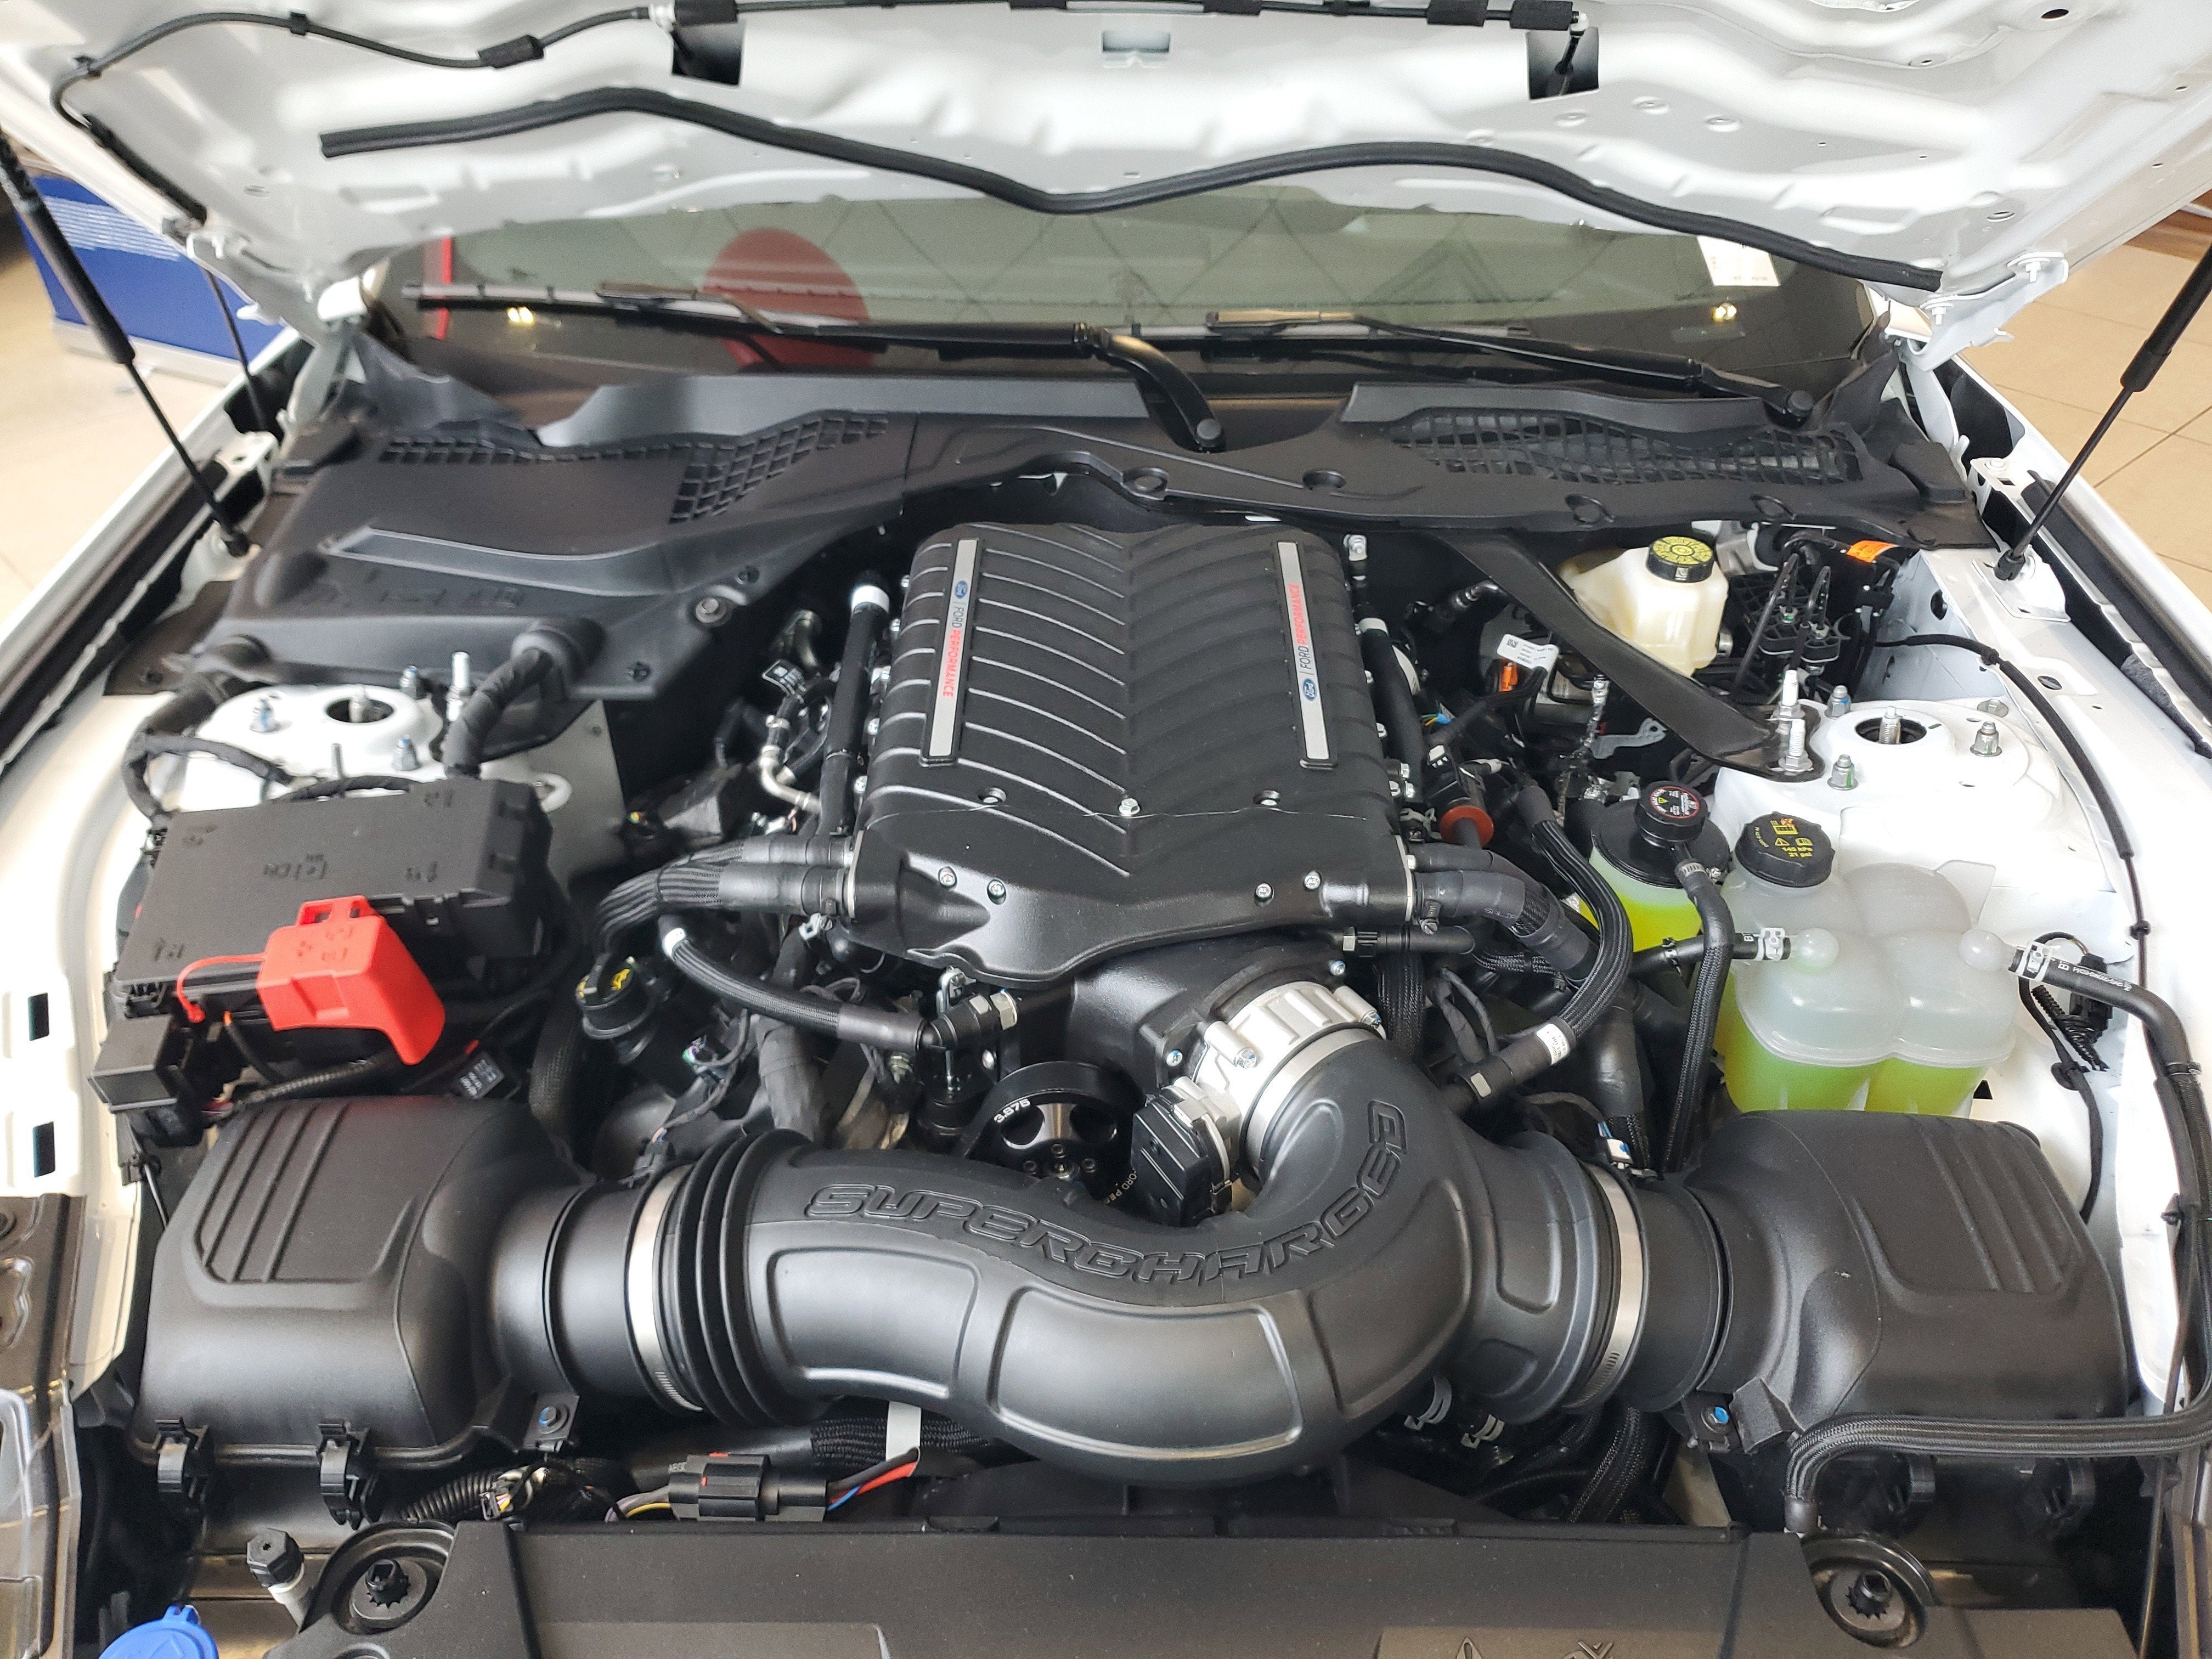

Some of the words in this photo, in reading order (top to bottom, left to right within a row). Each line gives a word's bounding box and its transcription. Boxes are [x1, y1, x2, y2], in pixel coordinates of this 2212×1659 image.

[951, 607, 964, 628] FORD
[1288, 583, 1308, 645] PERFORMANCE
[942, 628, 961, 698] PERFORMANCE
[1298, 645, 1312, 670] FORD
[804, 1099, 1407, 1284] SUPERCHARGED
